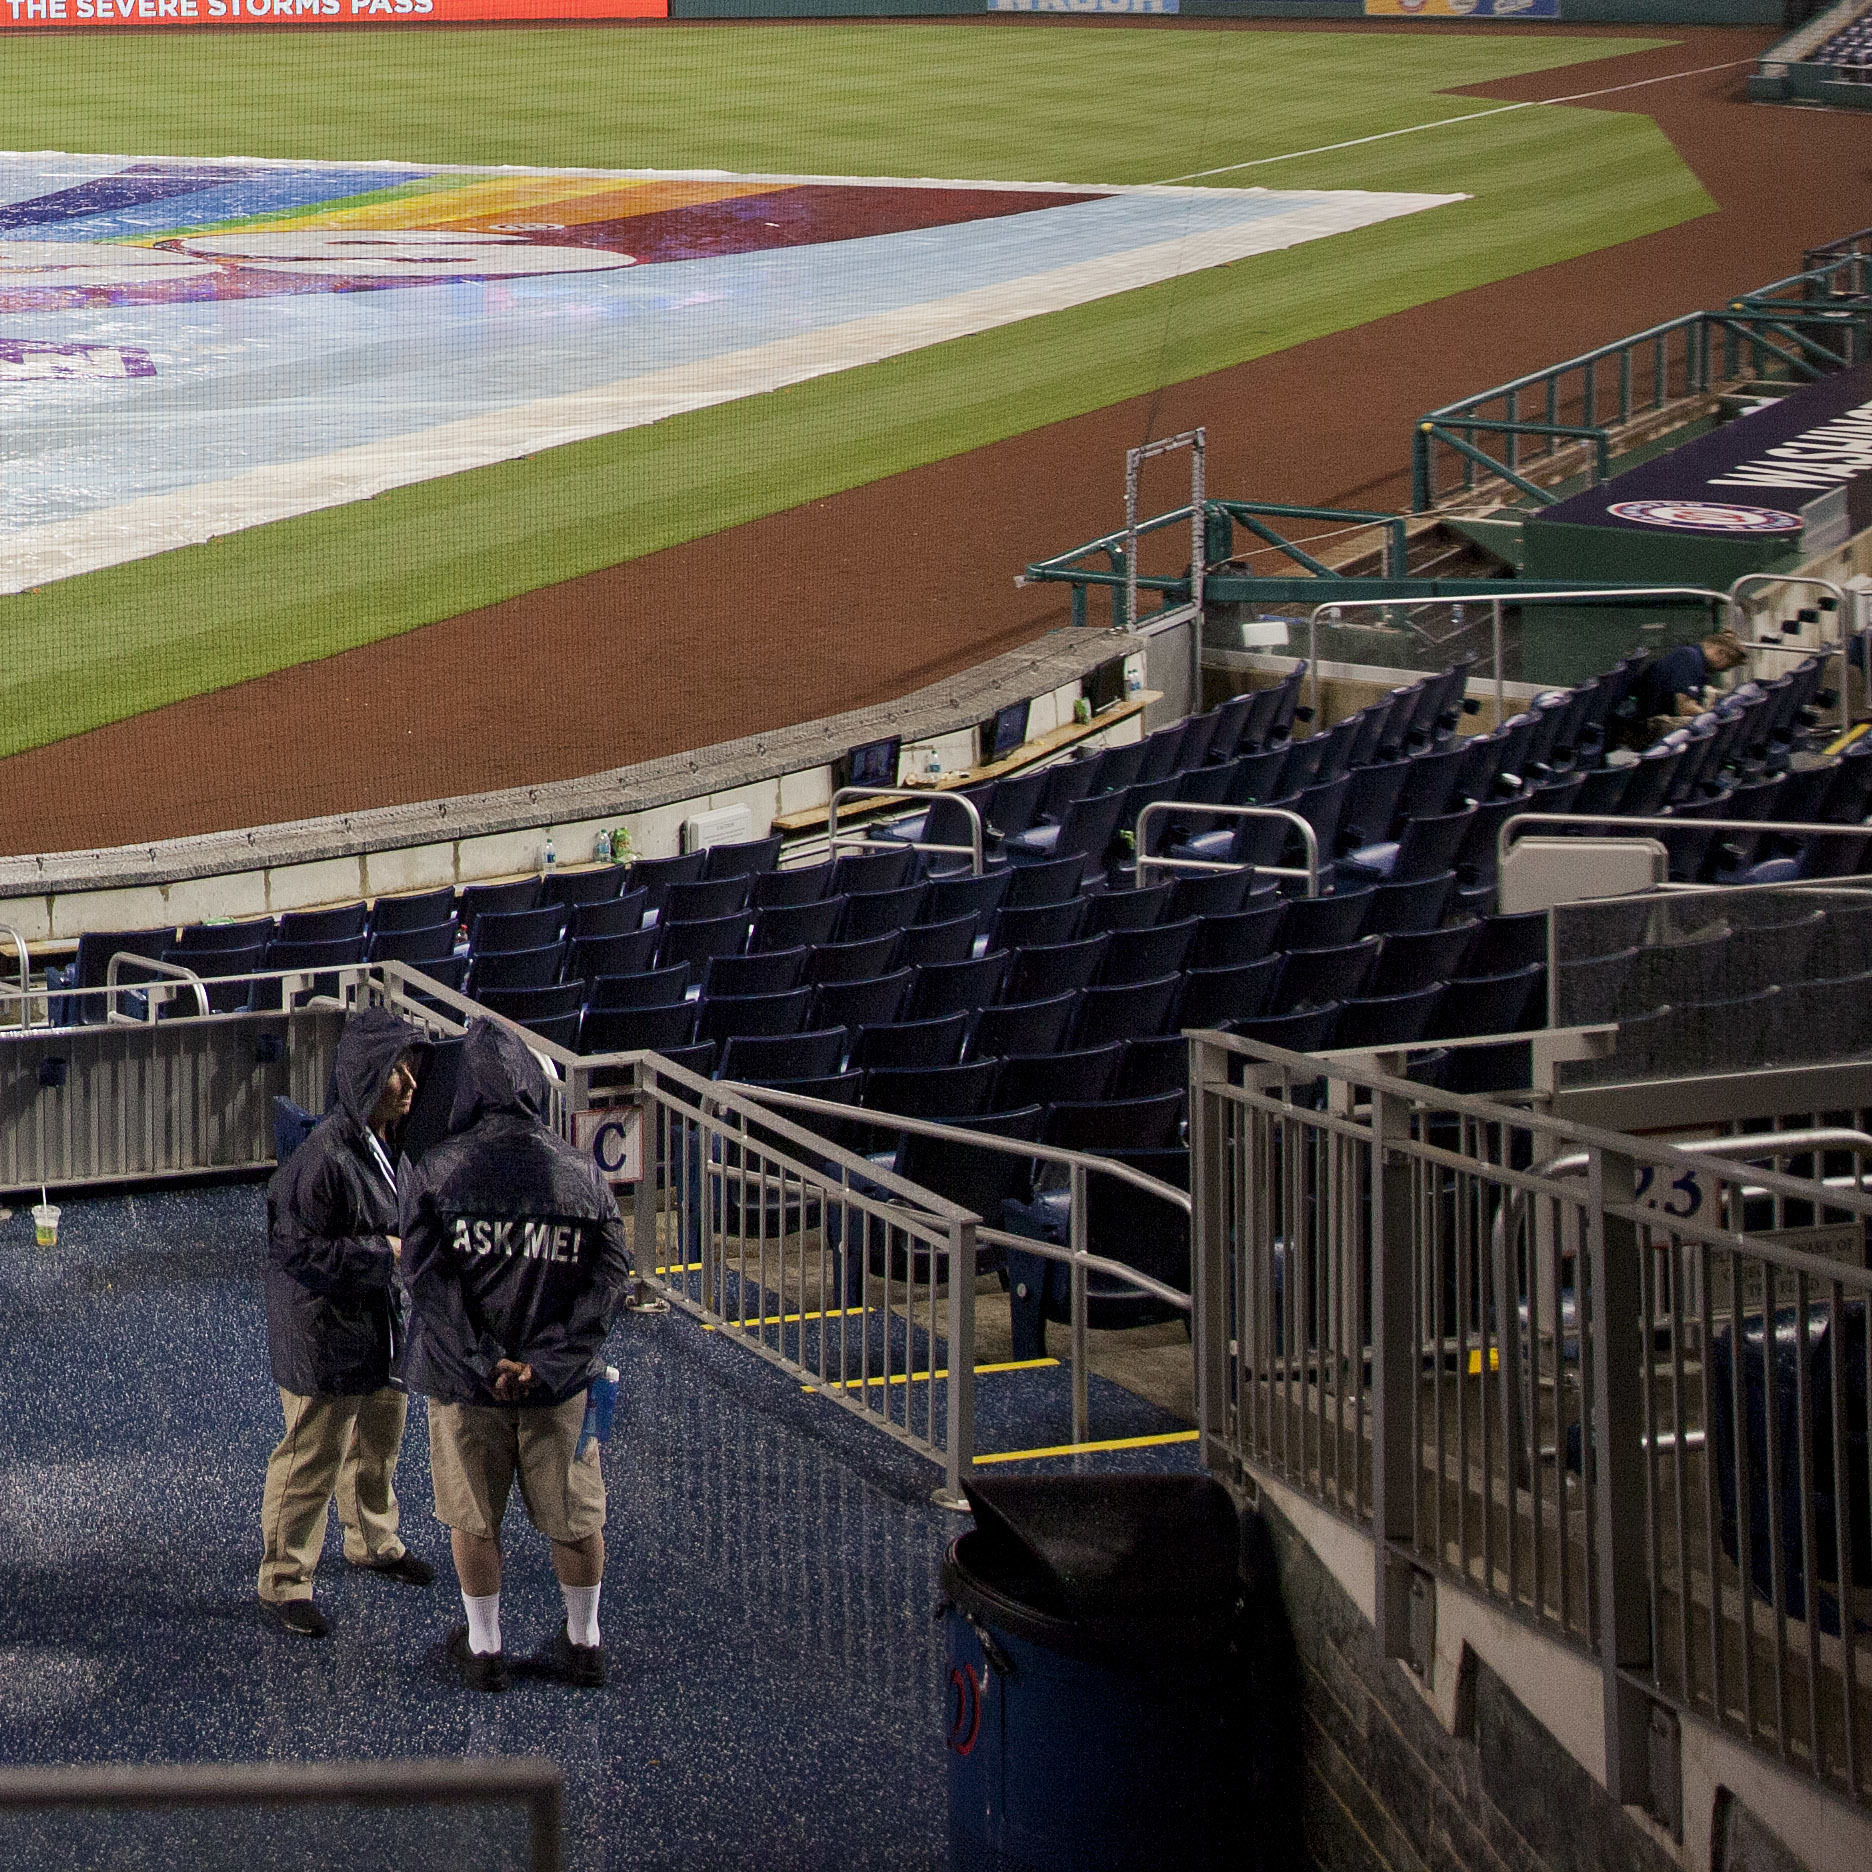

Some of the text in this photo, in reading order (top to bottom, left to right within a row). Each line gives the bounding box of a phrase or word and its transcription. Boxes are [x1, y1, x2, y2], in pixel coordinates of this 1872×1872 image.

[592, 1121, 628, 1173] C
[452, 1217, 581, 1265] ASK ME!
